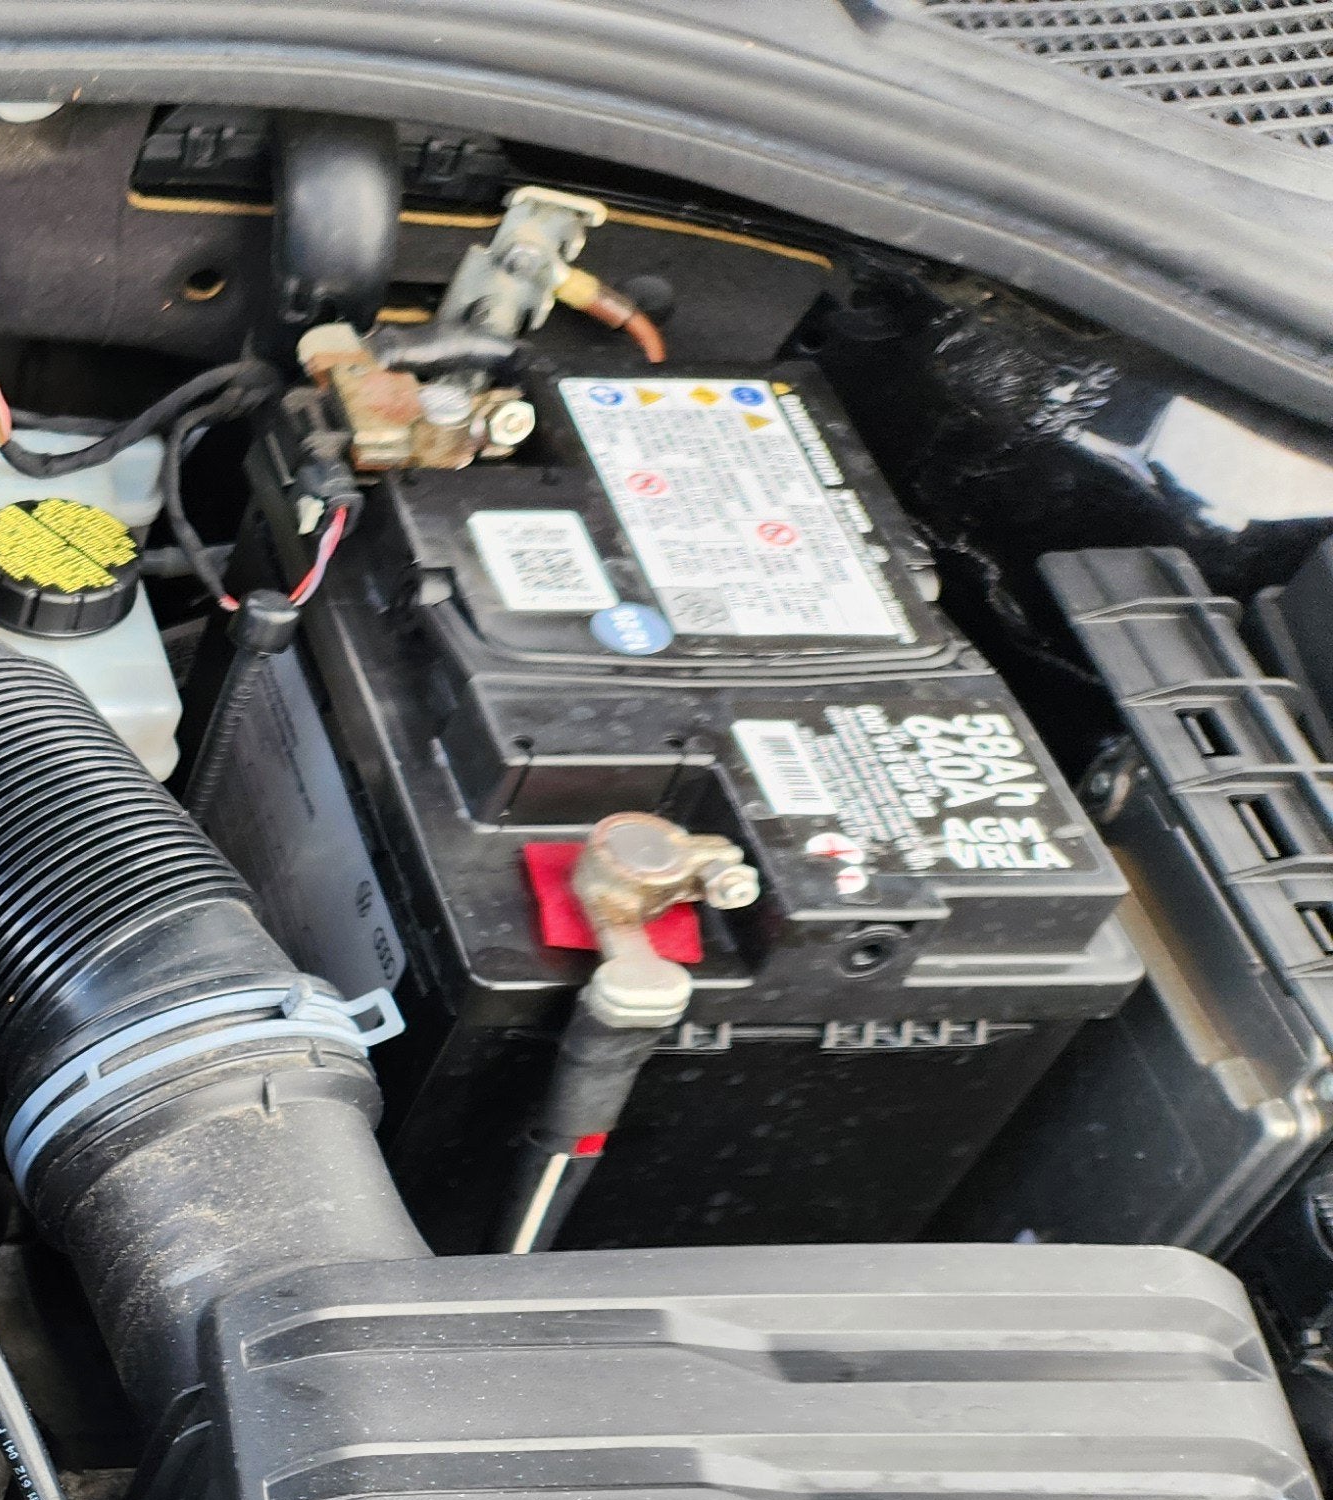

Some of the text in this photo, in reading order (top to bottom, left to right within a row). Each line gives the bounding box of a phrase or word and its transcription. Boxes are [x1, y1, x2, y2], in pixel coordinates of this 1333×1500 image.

[902, 715, 997, 808] 640A
[951, 714, 1048, 806] 58Ah
[943, 817, 1047, 842] AGM
[945, 843, 1074, 869] VRLA
[3, 1440, 19, 1460] 041
